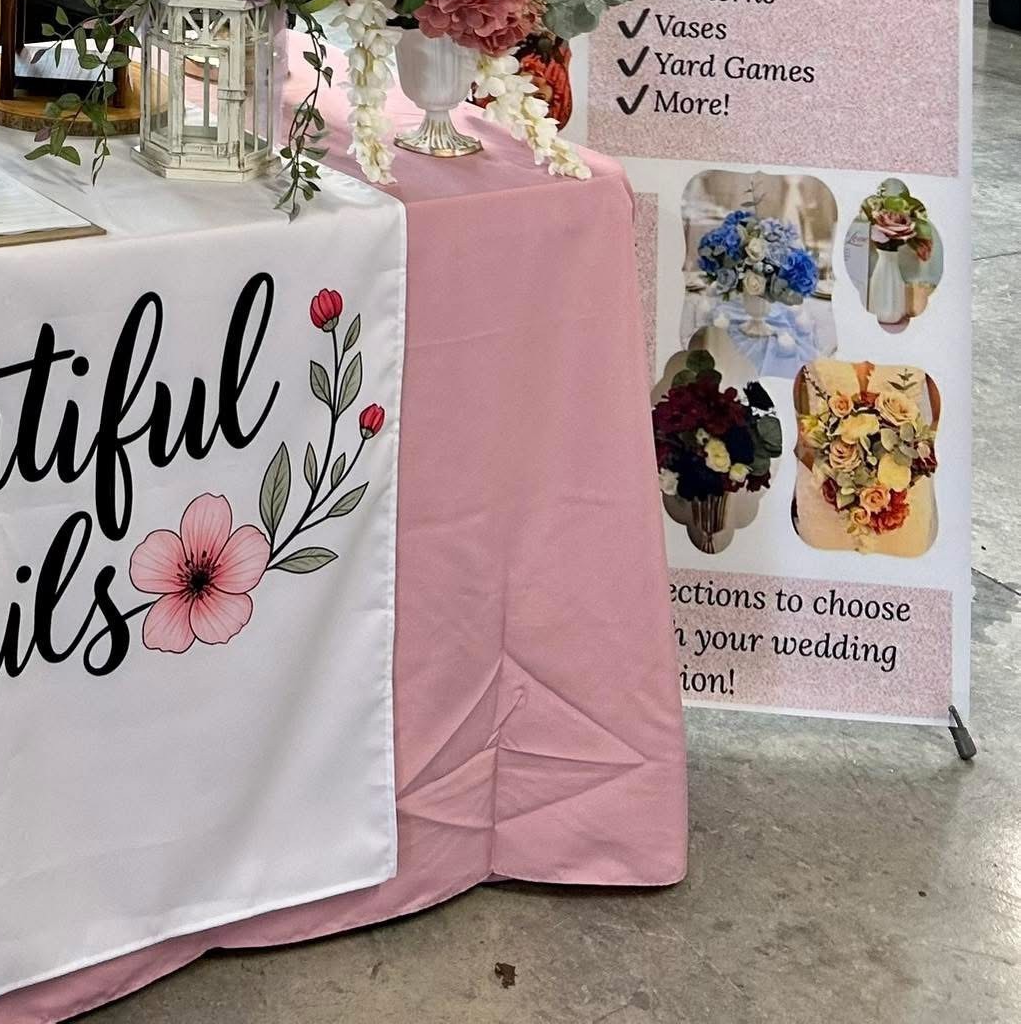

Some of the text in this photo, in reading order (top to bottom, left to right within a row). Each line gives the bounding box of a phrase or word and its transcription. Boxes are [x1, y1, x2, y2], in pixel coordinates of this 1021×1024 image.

[655, 15, 726, 39] Vases
[655, 53, 814, 83] Yard Games
[654, 90, 729, 116] More!
[776, 589, 802, 612] to
[813, 590, 910, 621] choose
[694, 630, 763, 656] your
[772, 633, 896, 672] wedding
